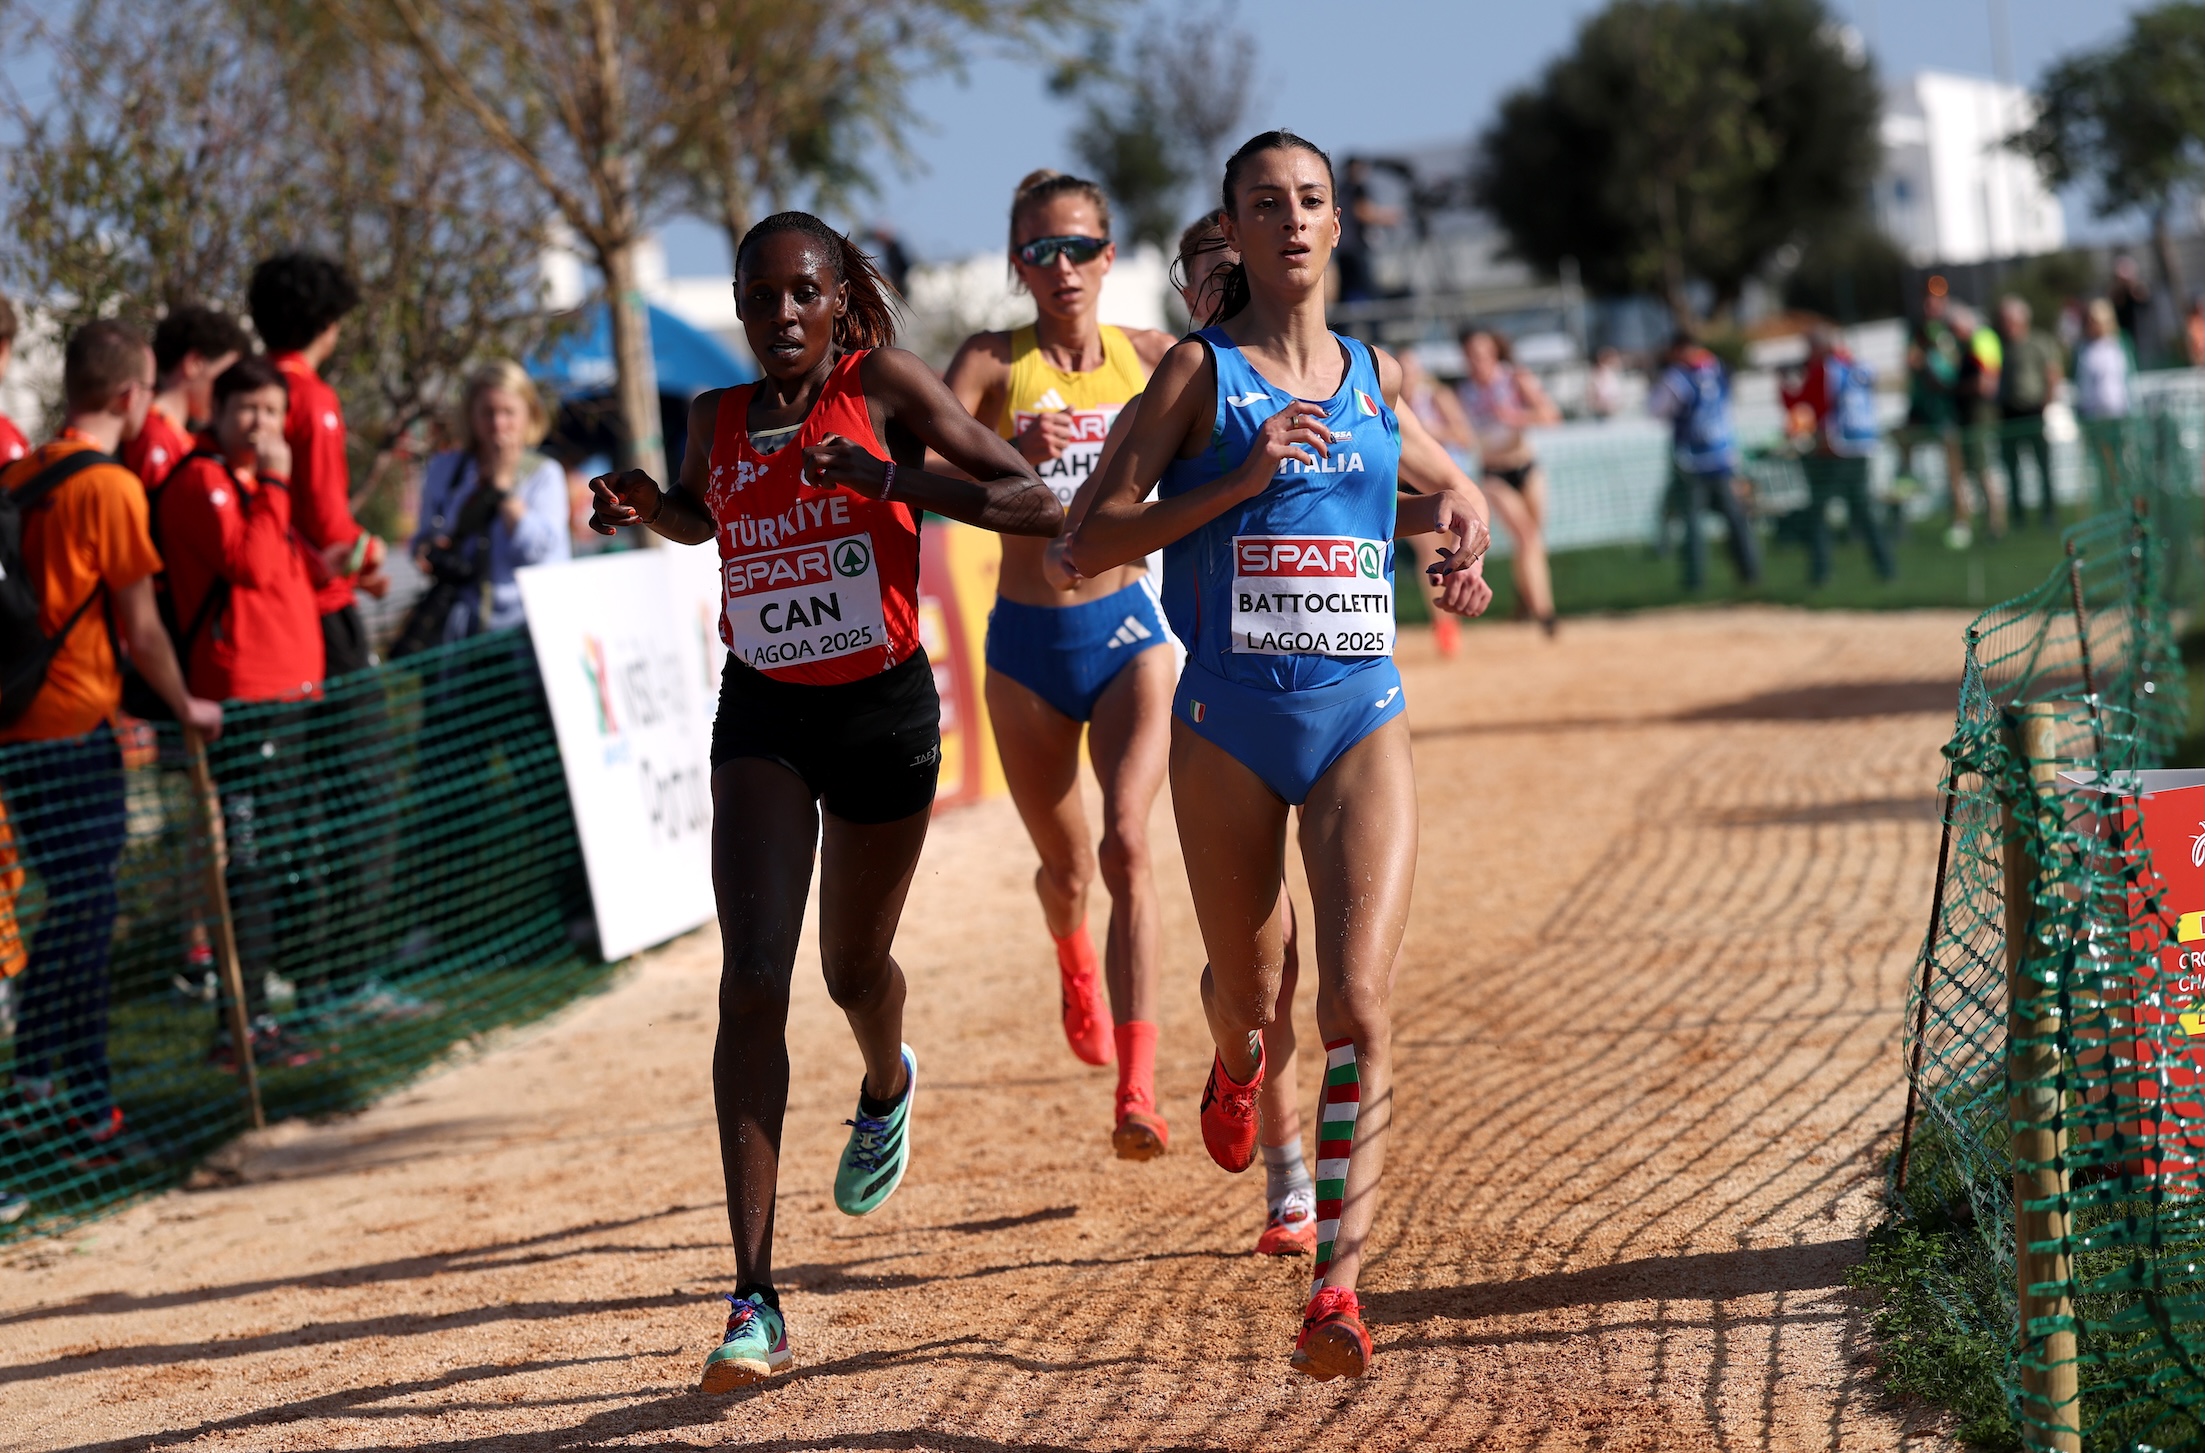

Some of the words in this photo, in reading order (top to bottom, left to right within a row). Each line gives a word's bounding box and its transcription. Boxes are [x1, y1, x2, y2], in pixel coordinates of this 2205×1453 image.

[1280, 452, 1365, 474] ITALIA
[726, 496, 851, 549] TÜRKİYE
[728, 551, 829, 593] SPAR
[1241, 544, 1355, 572] SPAR
[759, 592, 842, 634] CAN
[1239, 593, 1389, 614] BATTOCLETTI
[744, 639, 816, 666] LAGOA
[819, 625, 873, 655] 2025
[1247, 631, 1330, 652] LAGOA
[1336, 632, 1385, 652] 2025
